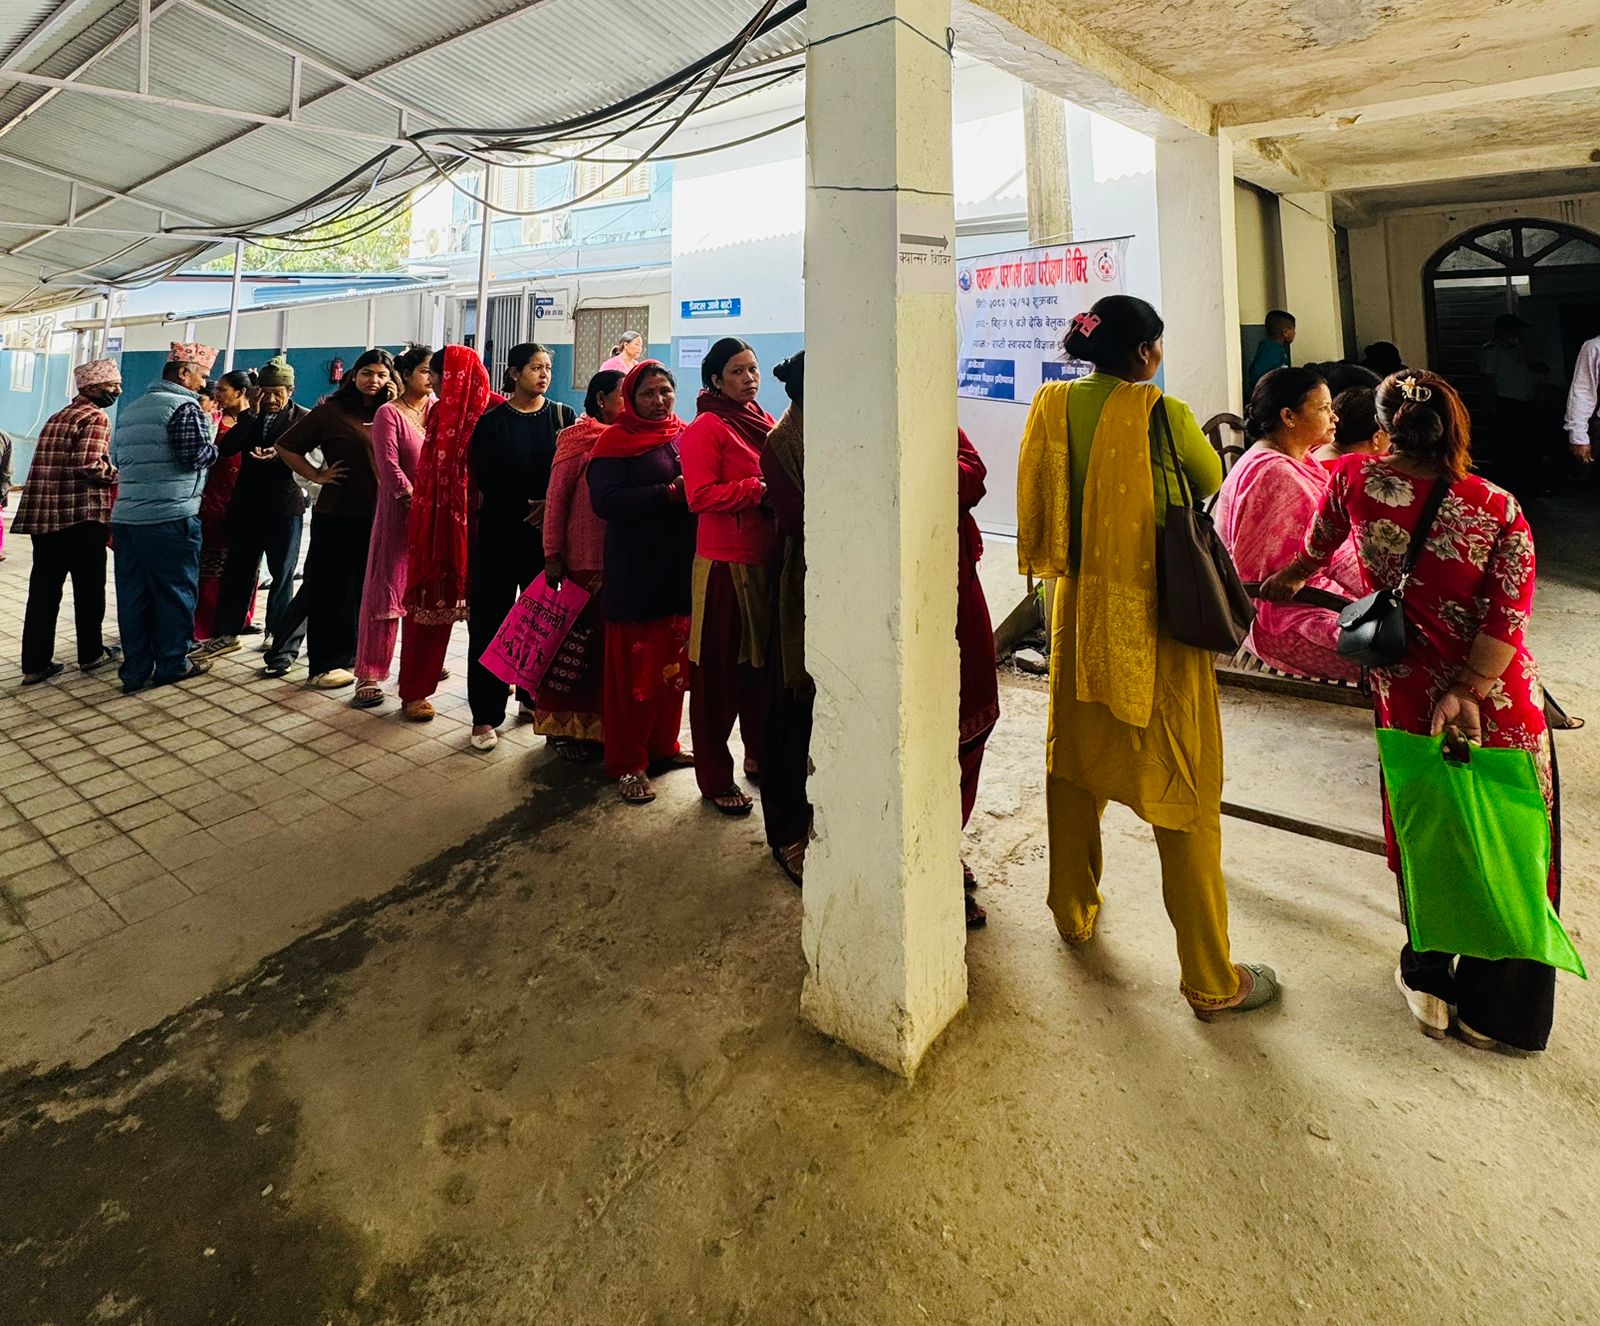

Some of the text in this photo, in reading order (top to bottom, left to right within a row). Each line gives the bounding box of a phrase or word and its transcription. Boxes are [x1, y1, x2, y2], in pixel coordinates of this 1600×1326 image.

[899, 249, 951, 266] क्यान्सर शिविर
[1024, 262, 1037, 288] तथा
[1038, 252, 1063, 288] परीक्षण
[1065, 247, 1089, 286] शिविर
[1016, 316, 1027, 328] बजे
[1029, 316, 1043, 330] देखि
